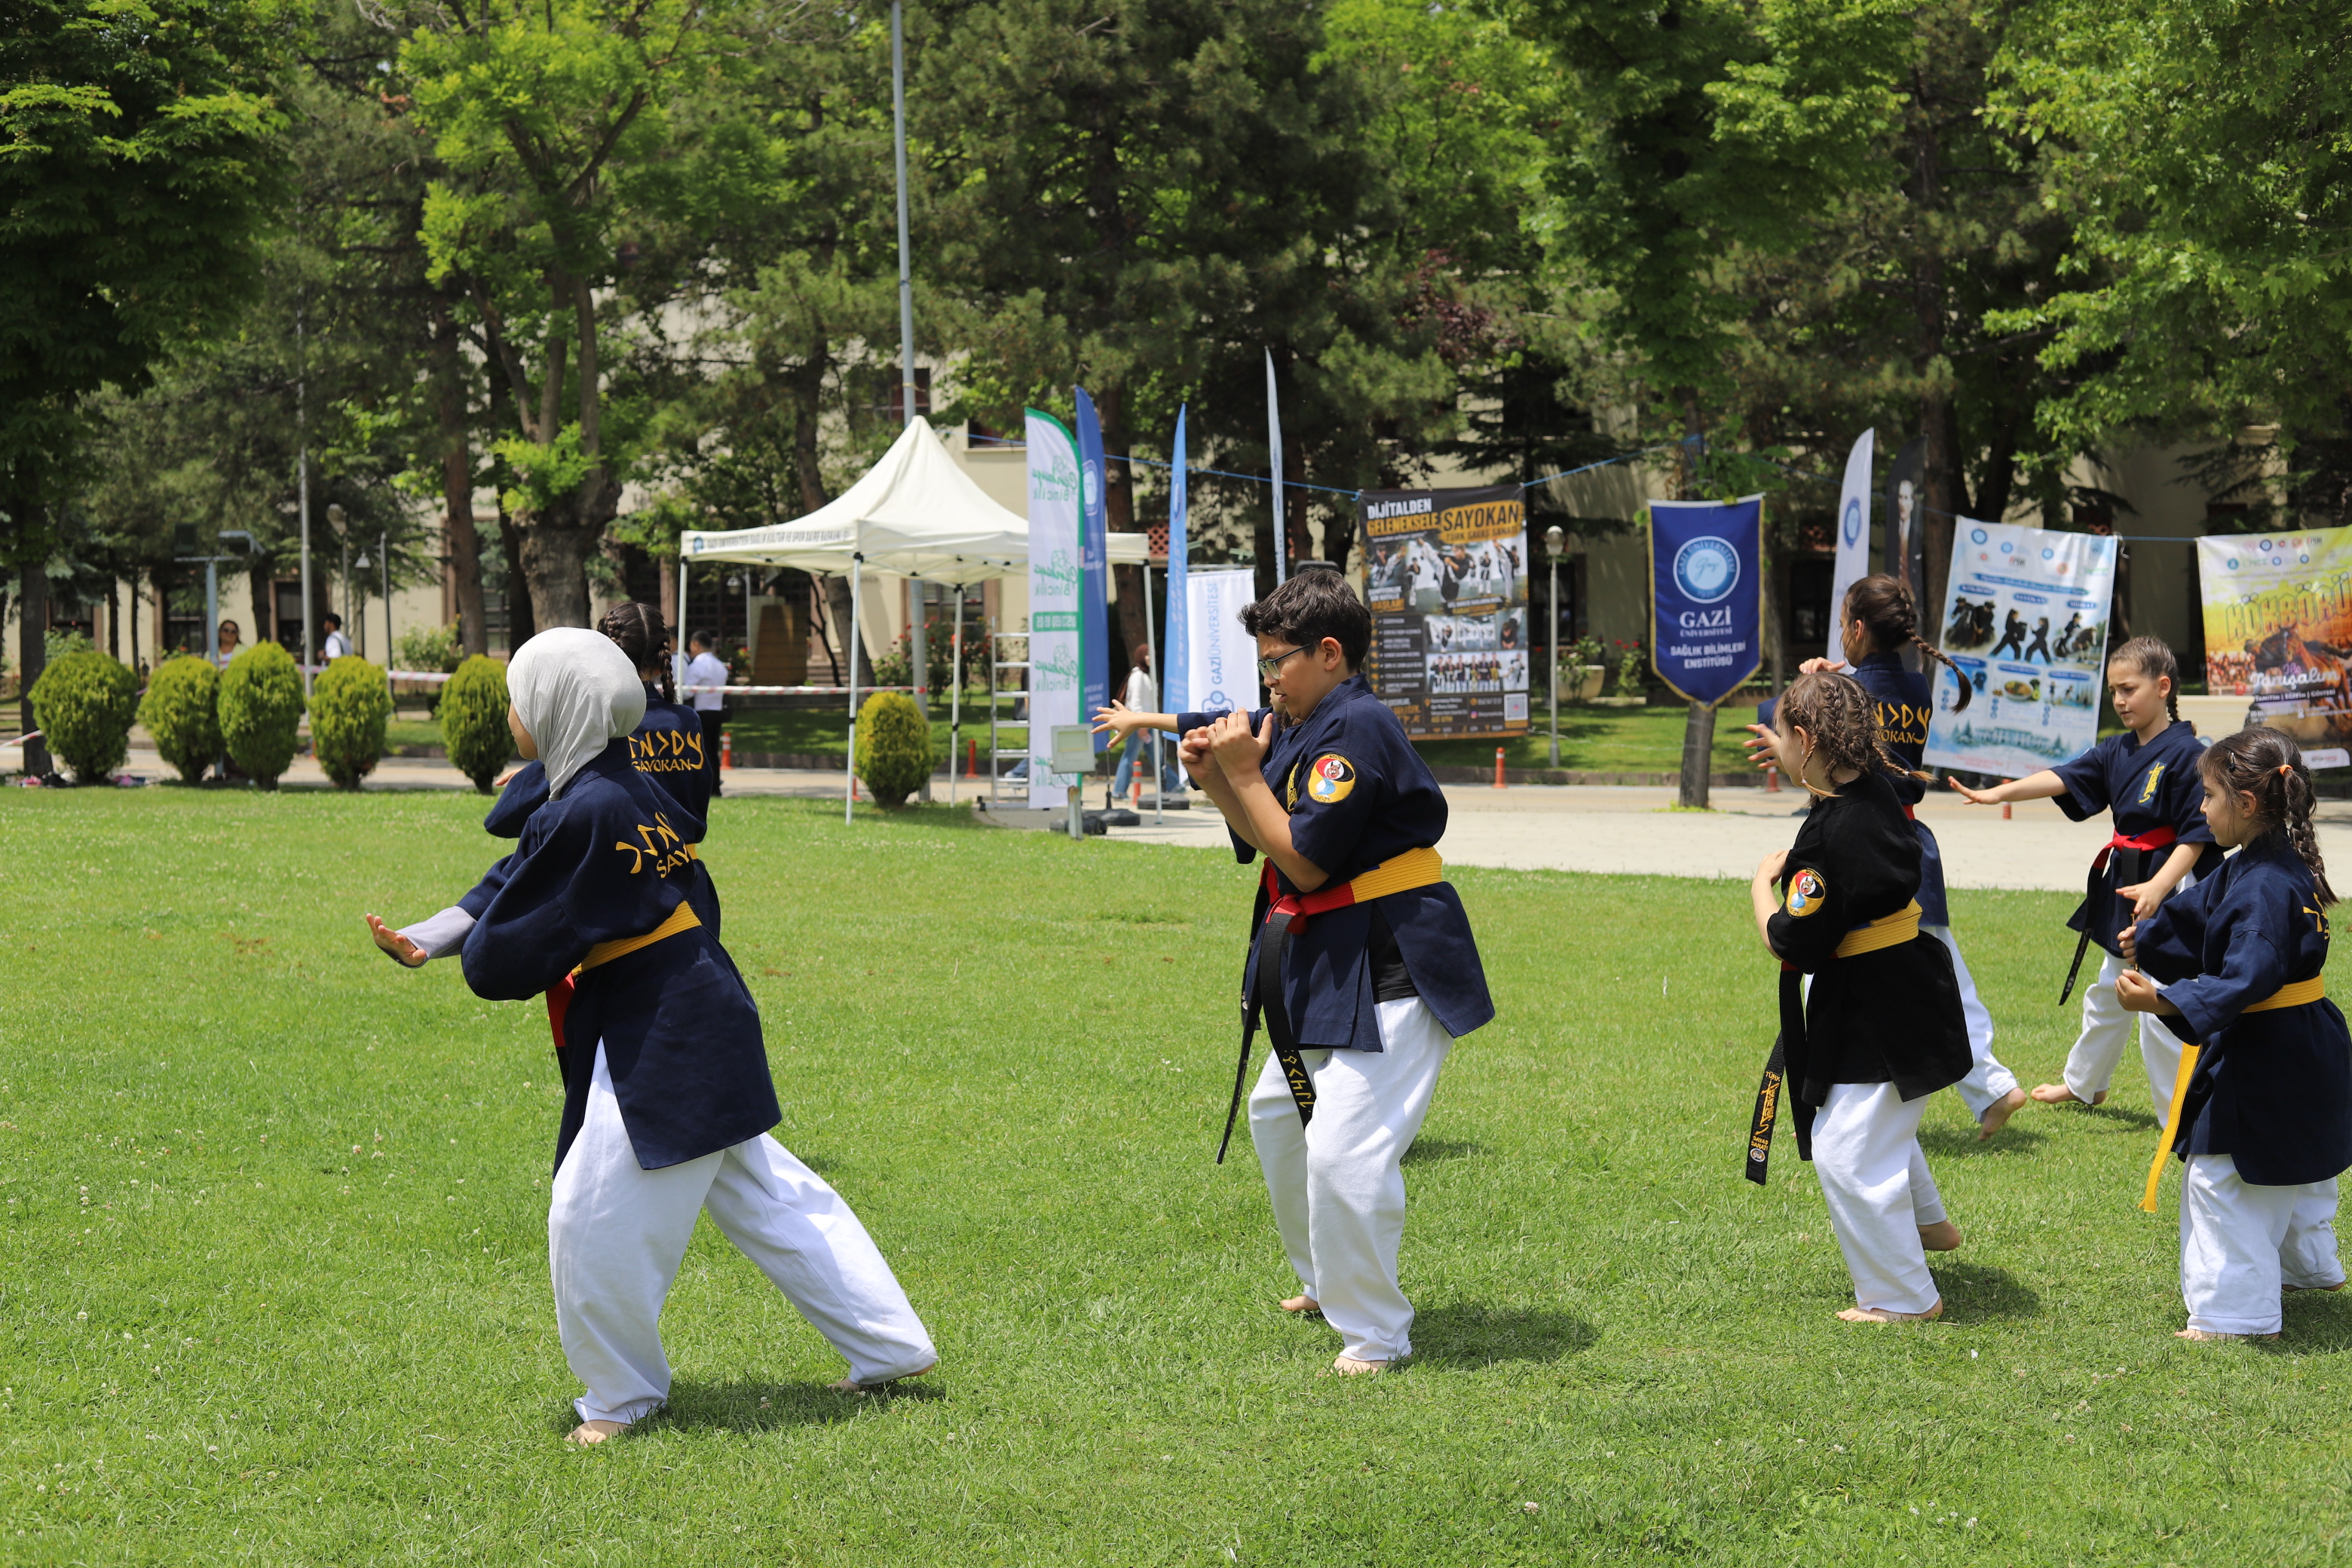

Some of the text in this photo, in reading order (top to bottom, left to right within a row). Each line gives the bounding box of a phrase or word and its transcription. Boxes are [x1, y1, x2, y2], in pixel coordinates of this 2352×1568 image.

[1367, 497, 1432, 519] DİJİTALDEN
[1444, 504, 1519, 531] SAYOKAN
[1679, 605, 1732, 629] GAZİ
[1670, 639, 1746, 657] SAĞLIK BİLİMLERİ
[1684, 654, 1733, 669] ENSTİTÜSÜ
[631, 758, 691, 772] SAYOKAN
[1766, 1070, 1781, 1082] TÜRK
